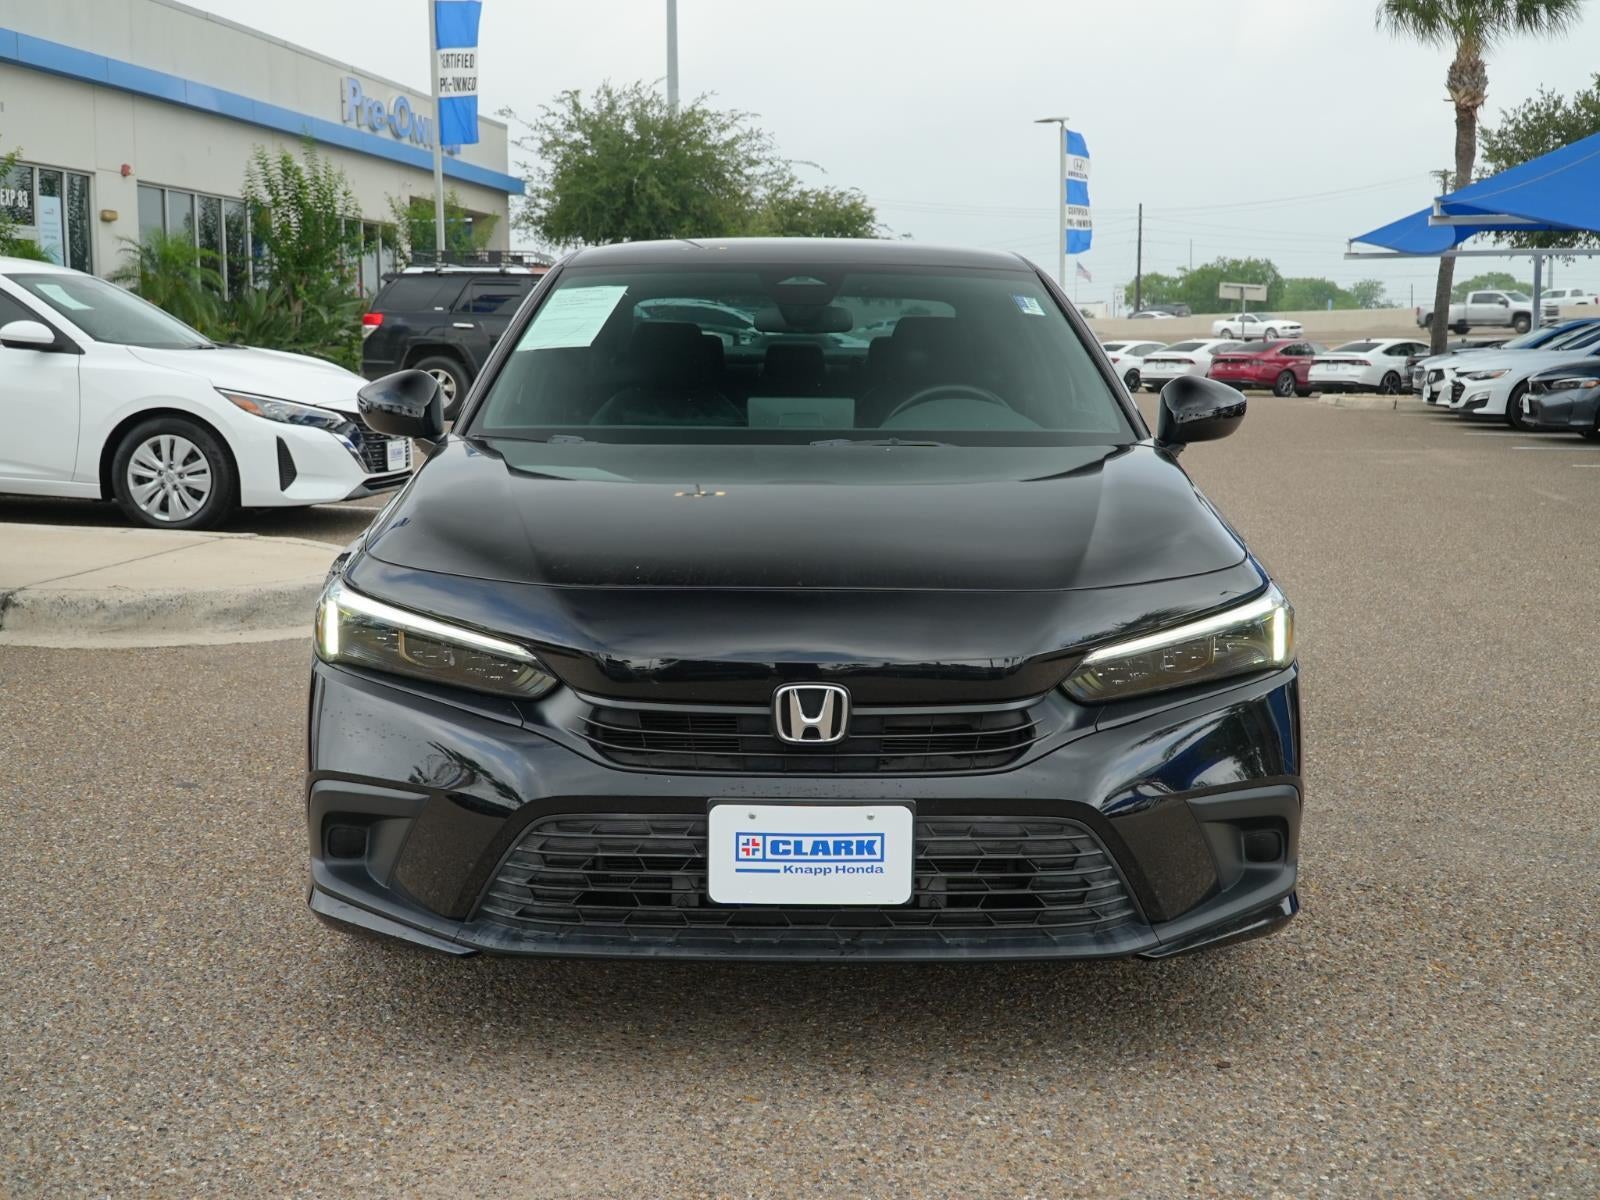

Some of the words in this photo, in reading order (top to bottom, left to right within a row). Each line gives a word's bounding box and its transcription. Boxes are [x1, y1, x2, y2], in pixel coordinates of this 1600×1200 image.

[340, 77, 461, 156] Pre-Own
[17, 190, 28, 208] 83
[770, 839, 877, 856] CLARK
[783, 865, 832, 876] Knapp
[835, 865, 884, 874] Honda
